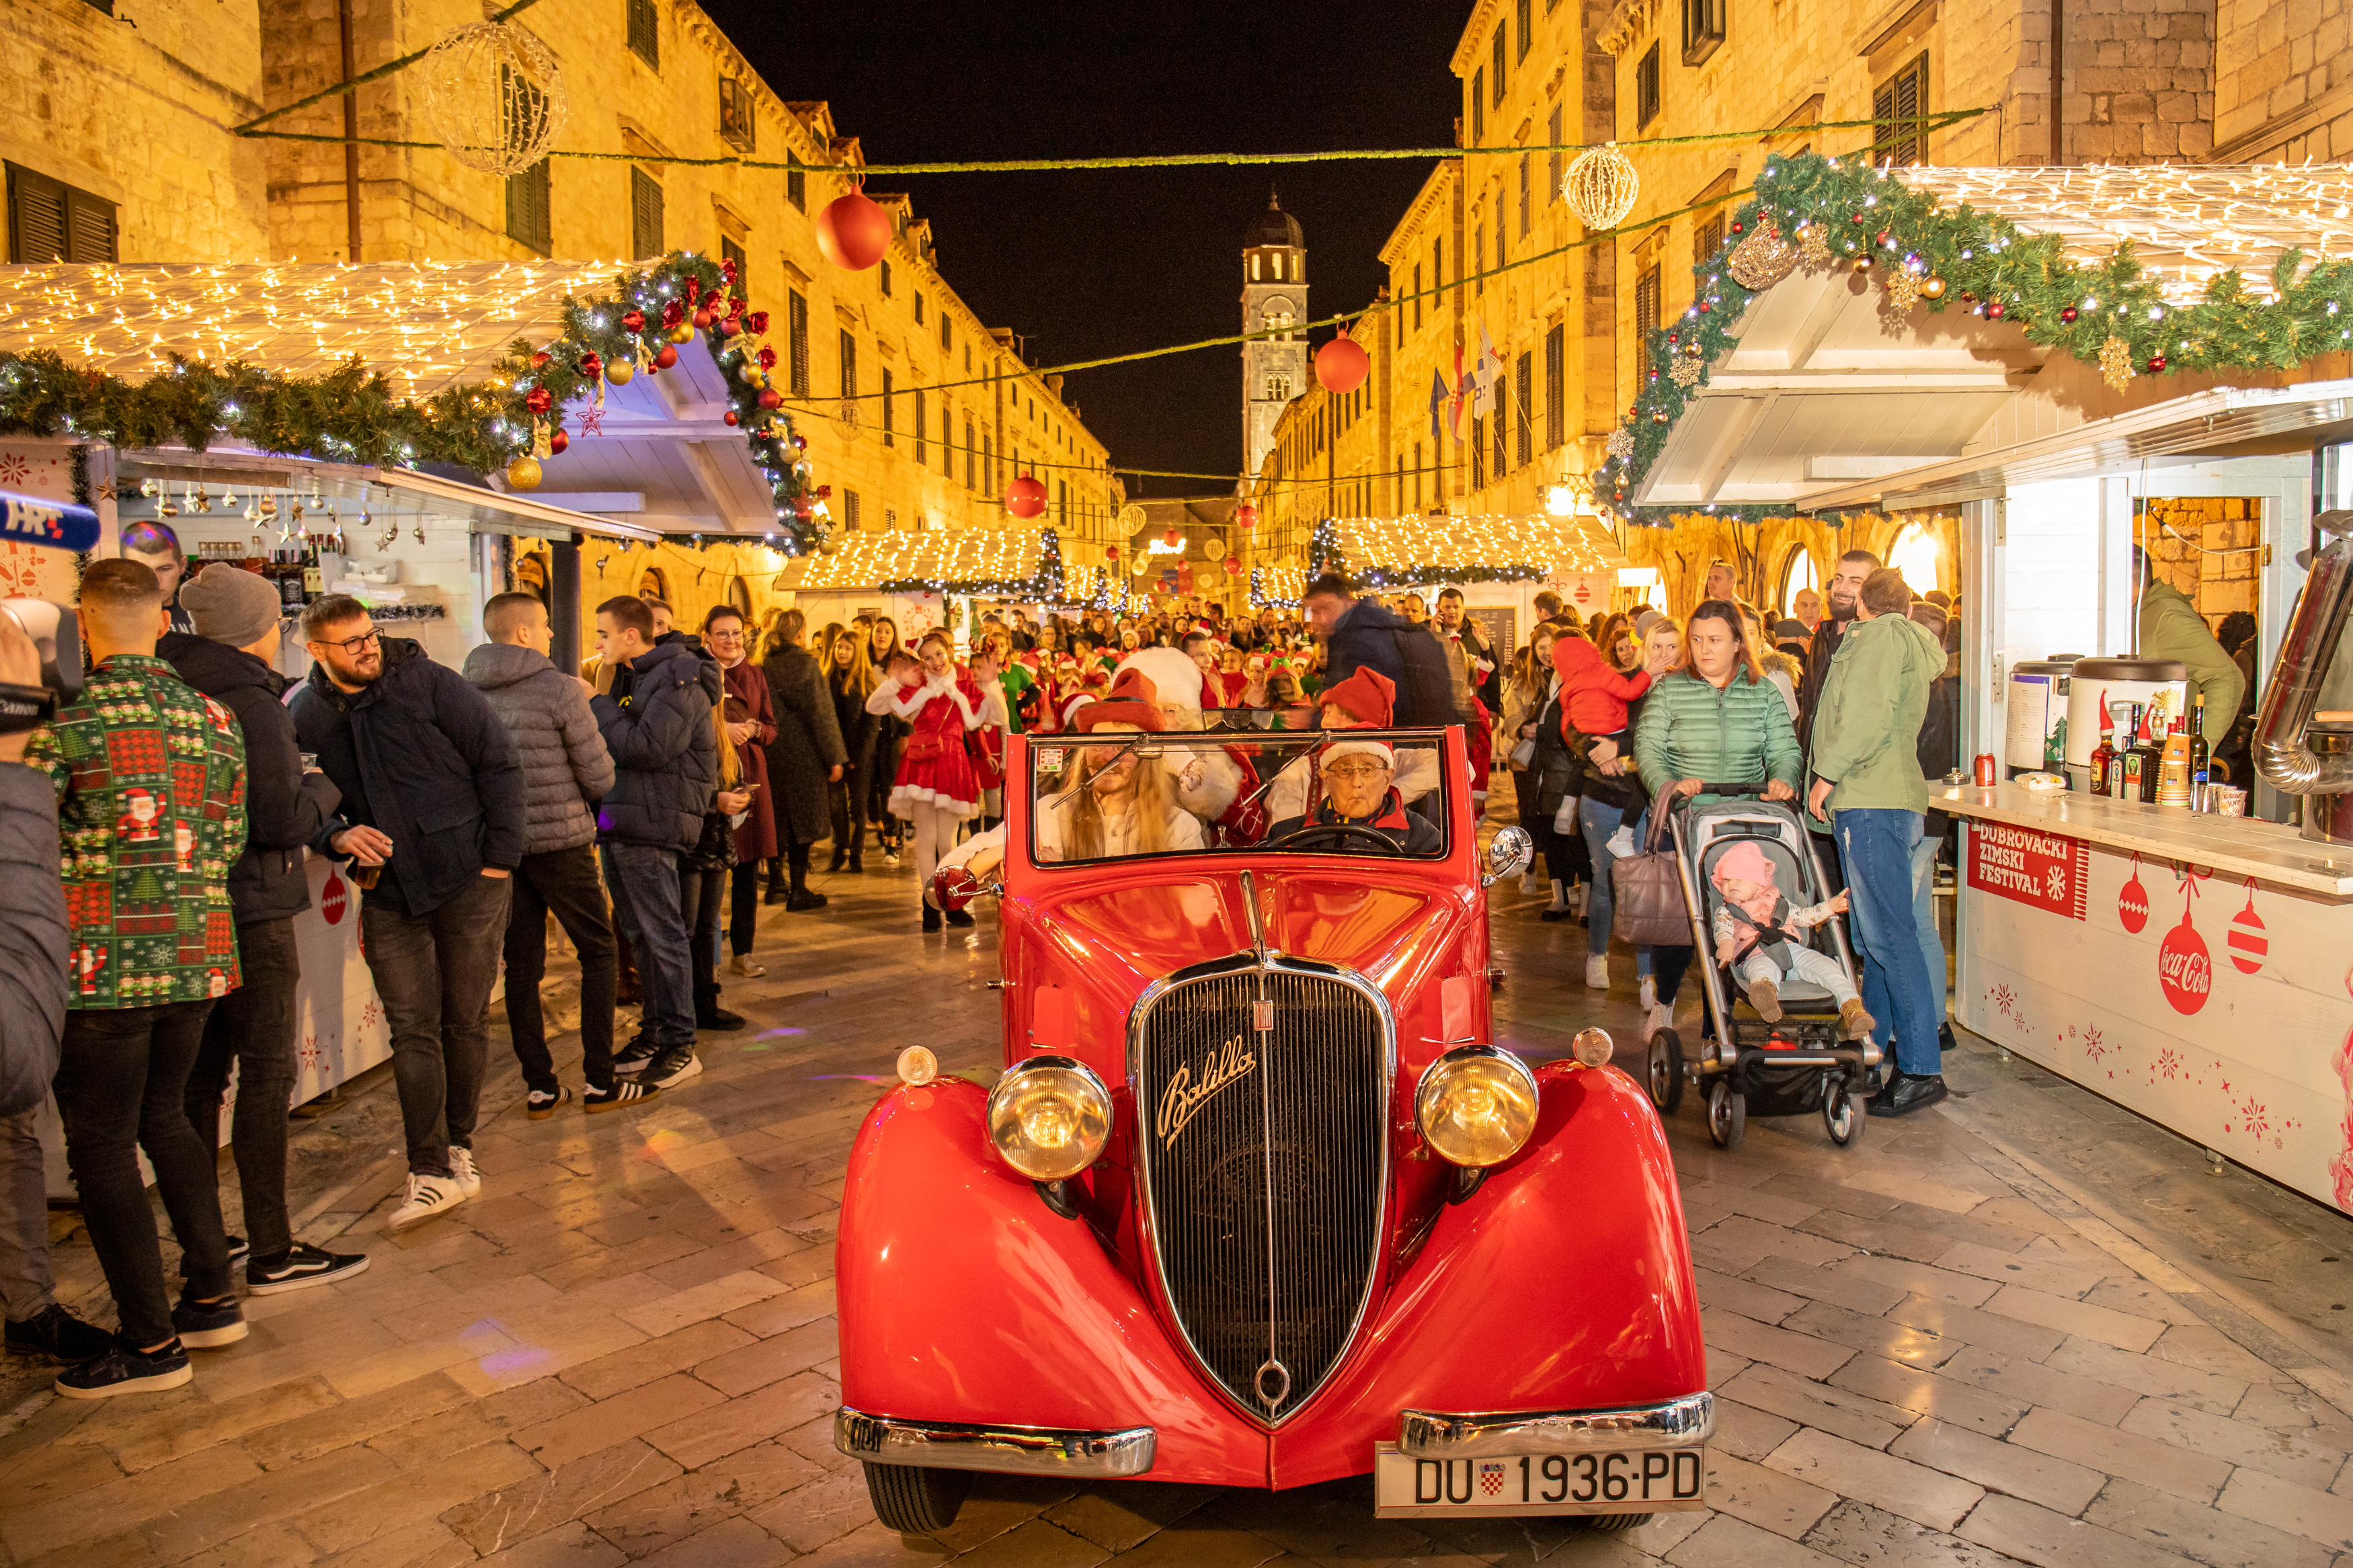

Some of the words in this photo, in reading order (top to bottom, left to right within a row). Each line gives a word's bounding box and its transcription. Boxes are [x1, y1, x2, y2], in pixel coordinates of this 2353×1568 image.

[5, 498, 64, 539] HRT
[1979, 823, 2068, 860] DUBROVAČKI
[1979, 842, 2025, 871] ZIMSKI
[1979, 862, 2042, 897] FESTIVAL
[2160, 945, 2208, 993] Coca-Cola
[1256, 1003, 1271, 1028] FIAT
[1157, 1034, 1257, 1151] Balilla
[1415, 1459, 1473, 1504] DU
